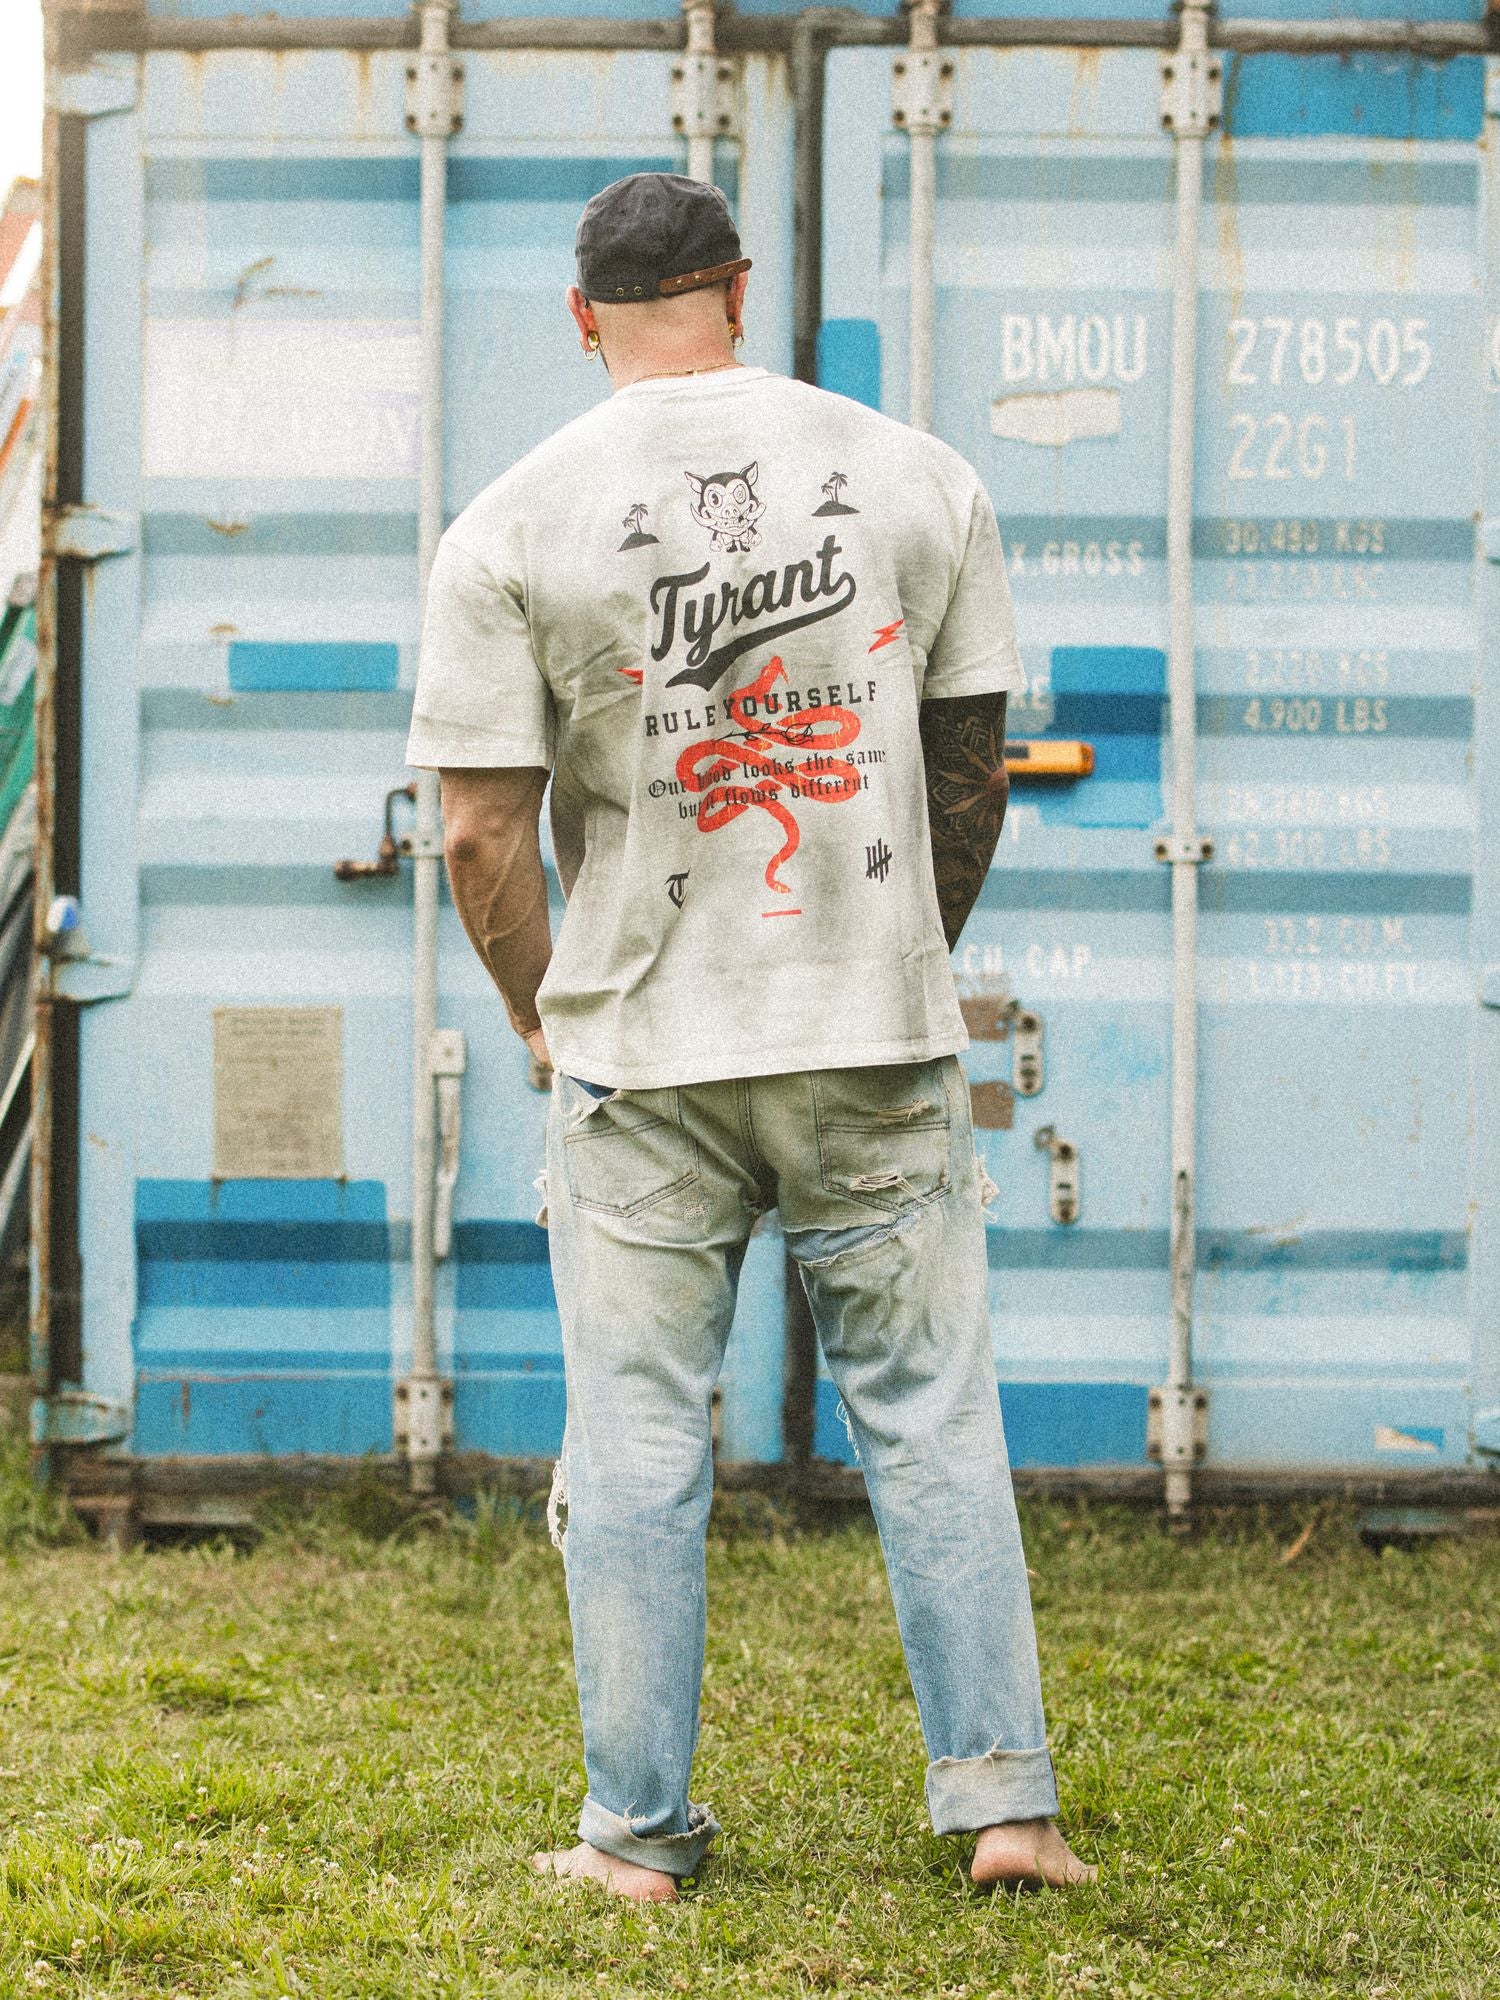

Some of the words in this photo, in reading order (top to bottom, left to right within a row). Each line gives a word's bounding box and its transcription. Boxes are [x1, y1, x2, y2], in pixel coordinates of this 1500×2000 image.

[1001, 314, 1148, 383] BMOU
[1227, 317, 1432, 385] 278505
[1227, 412, 1357, 480] 22G1
[650, 534, 857, 672] Tyrant
[645, 703, 717, 737] RULE
[723, 681, 877, 720] YOURSELF
[1336, 698, 1390, 733] LBS
[648, 779, 687, 798] Our
[743, 757, 795, 780] looks
[806, 752, 834, 771] the
[725, 787, 778, 806] flows
[790, 774, 869, 799] different
